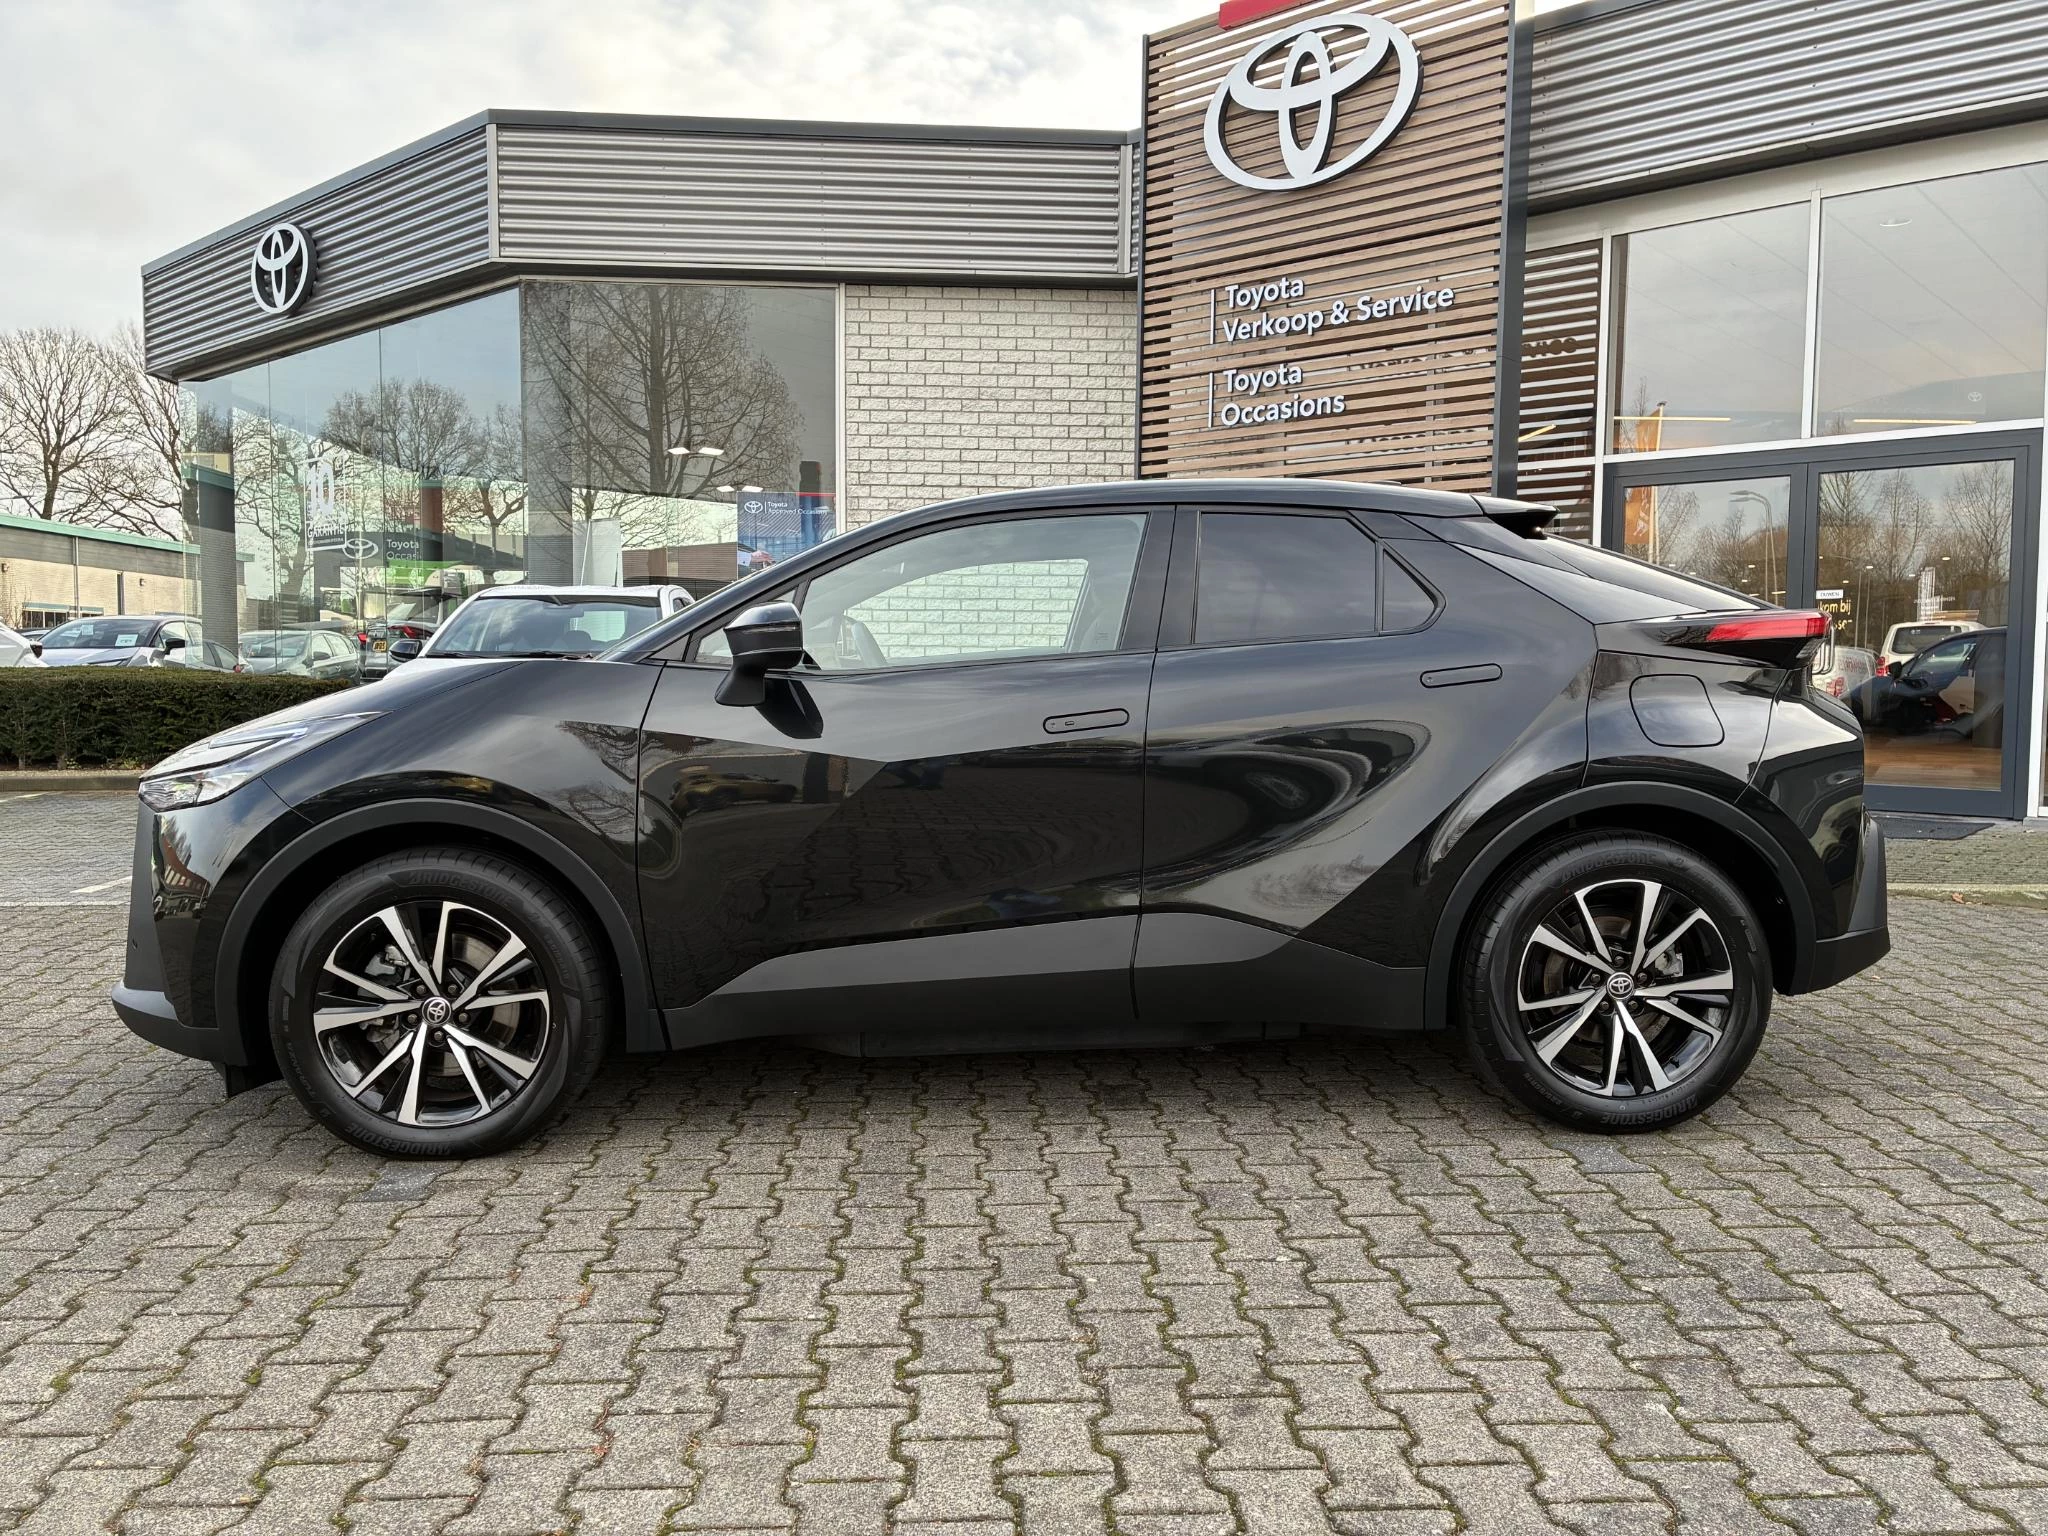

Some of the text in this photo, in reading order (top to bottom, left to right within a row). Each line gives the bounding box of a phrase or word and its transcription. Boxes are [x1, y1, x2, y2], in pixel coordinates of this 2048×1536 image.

[1225, 277, 1304, 310] Toyota
[1223, 286, 1455, 342] Verkoop & Service
[1223, 363, 1302, 395] Toyota
[1221, 394, 1345, 426] Occasions
[386, 551, 422, 560] Occasi
[387, 540, 420, 553] Toyota
[1840, 599, 1851, 615] bij
